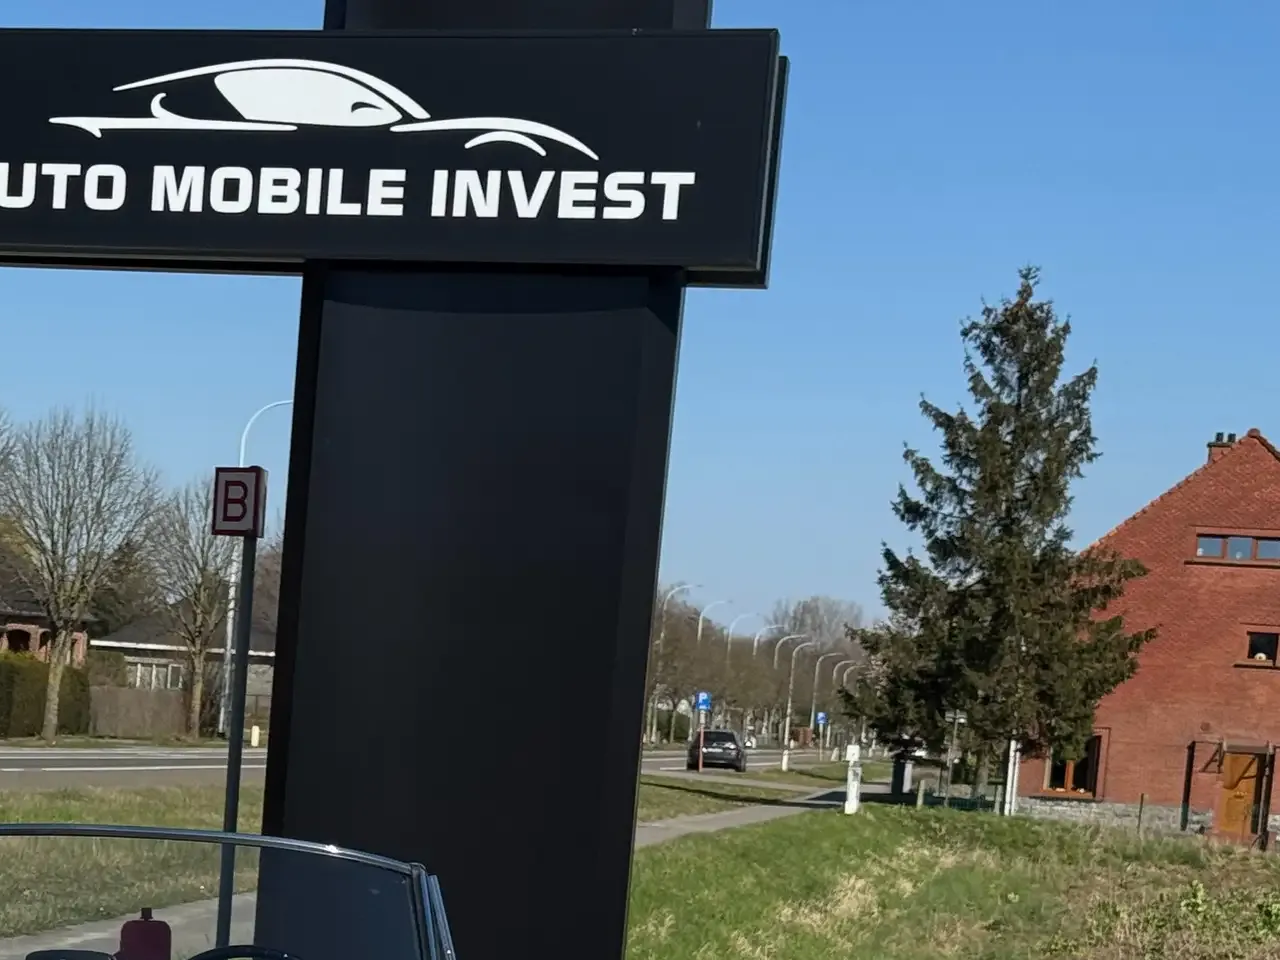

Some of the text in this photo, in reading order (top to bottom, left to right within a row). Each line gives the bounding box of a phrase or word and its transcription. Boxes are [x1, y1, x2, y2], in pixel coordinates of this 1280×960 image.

[150, 165, 407, 216] MOBILE
[430, 169, 696, 220] INVEST
[222, 480, 248, 522] B
[699, 692, 708, 704] P
